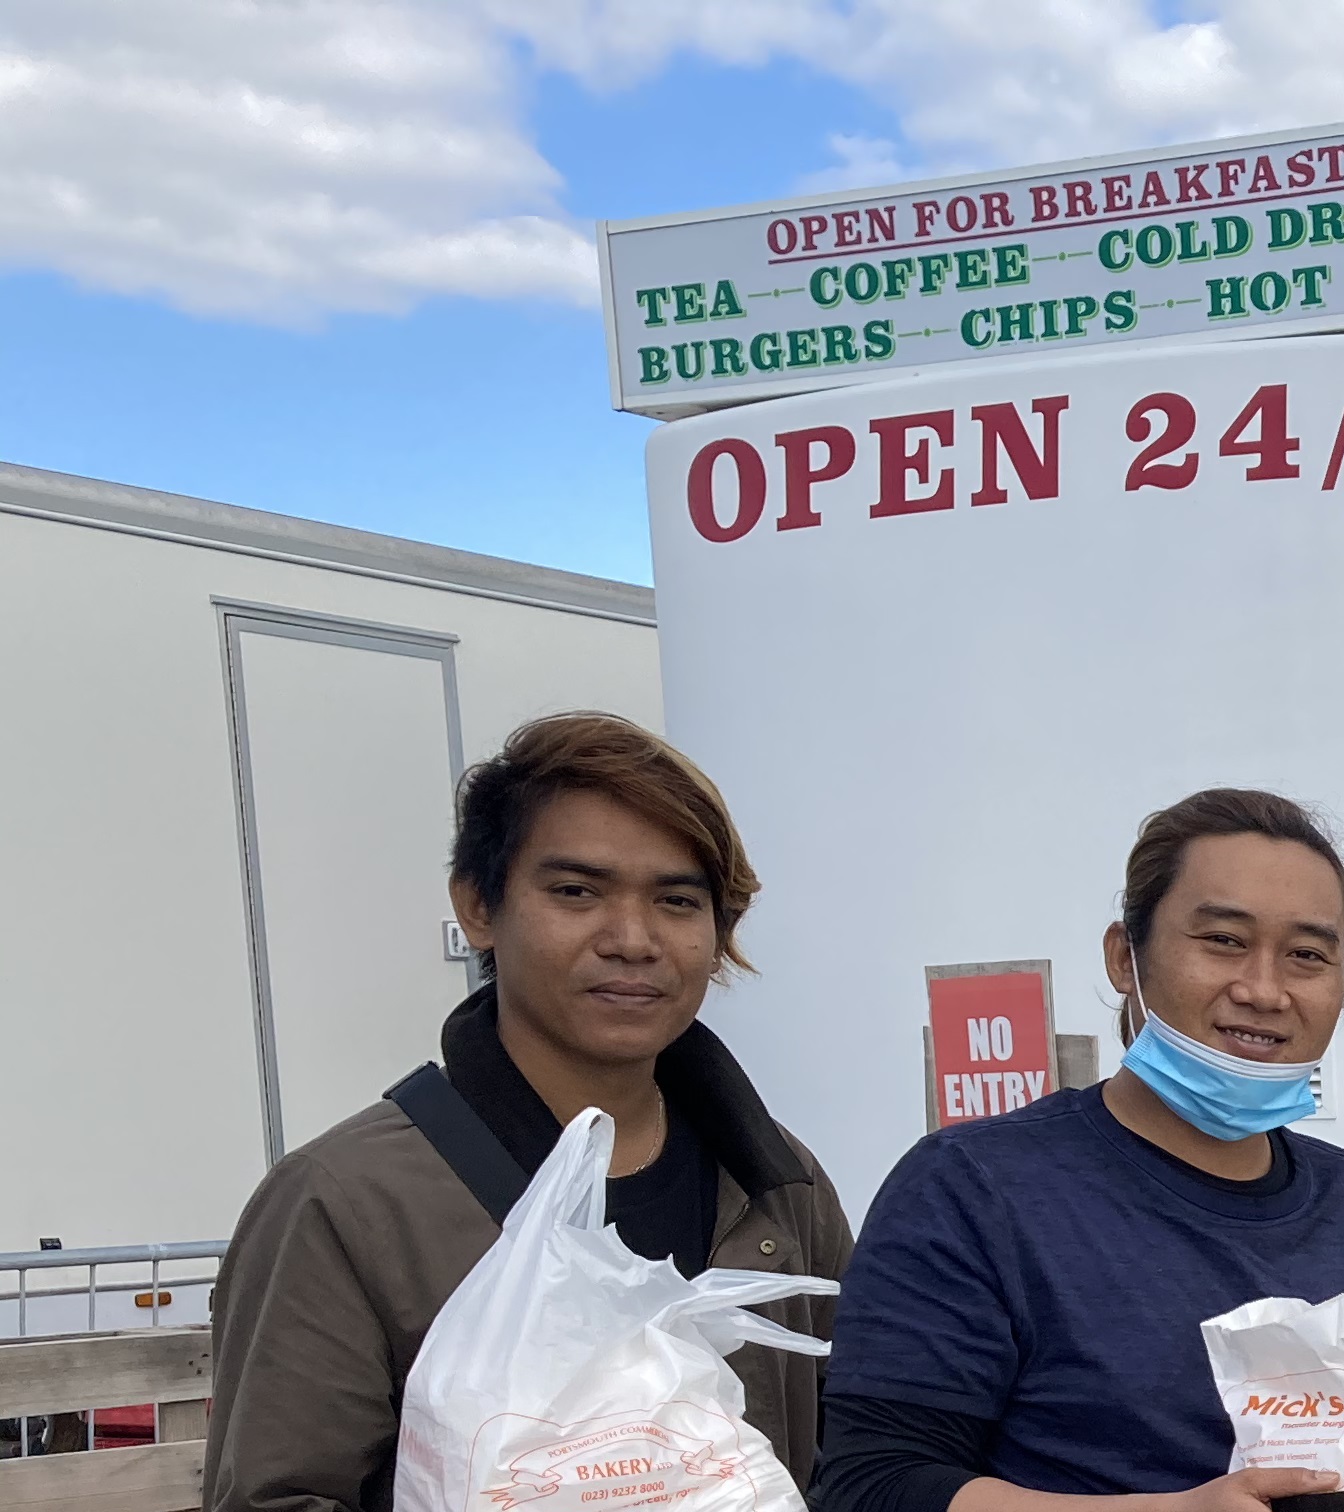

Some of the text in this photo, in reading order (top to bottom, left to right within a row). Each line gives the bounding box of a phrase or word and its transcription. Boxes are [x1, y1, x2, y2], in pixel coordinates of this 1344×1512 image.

[766, 203, 898, 257] OPEN
[914, 184, 1015, 235] FOR
[636, 277, 747, 329] TEA
[809, 243, 1032, 308] COFFEE
[1098, 216, 1254, 272] COLD
[638, 319, 896, 386] BURGERS
[960, 290, 1138, 351] CHIPS
[1205, 265, 1330, 321] HOT
[687, 394, 1069, 543] OPEN
[967, 1016, 1014, 1062] NO
[943, 1070, 1046, 1117] ENTRY
[576, 1456, 655, 1481] BAKERY
[581, 1490, 609, 1503] (023)
[611, 1485, 637, 1497] 9232
[640, 1481, 665, 1493] 8000
